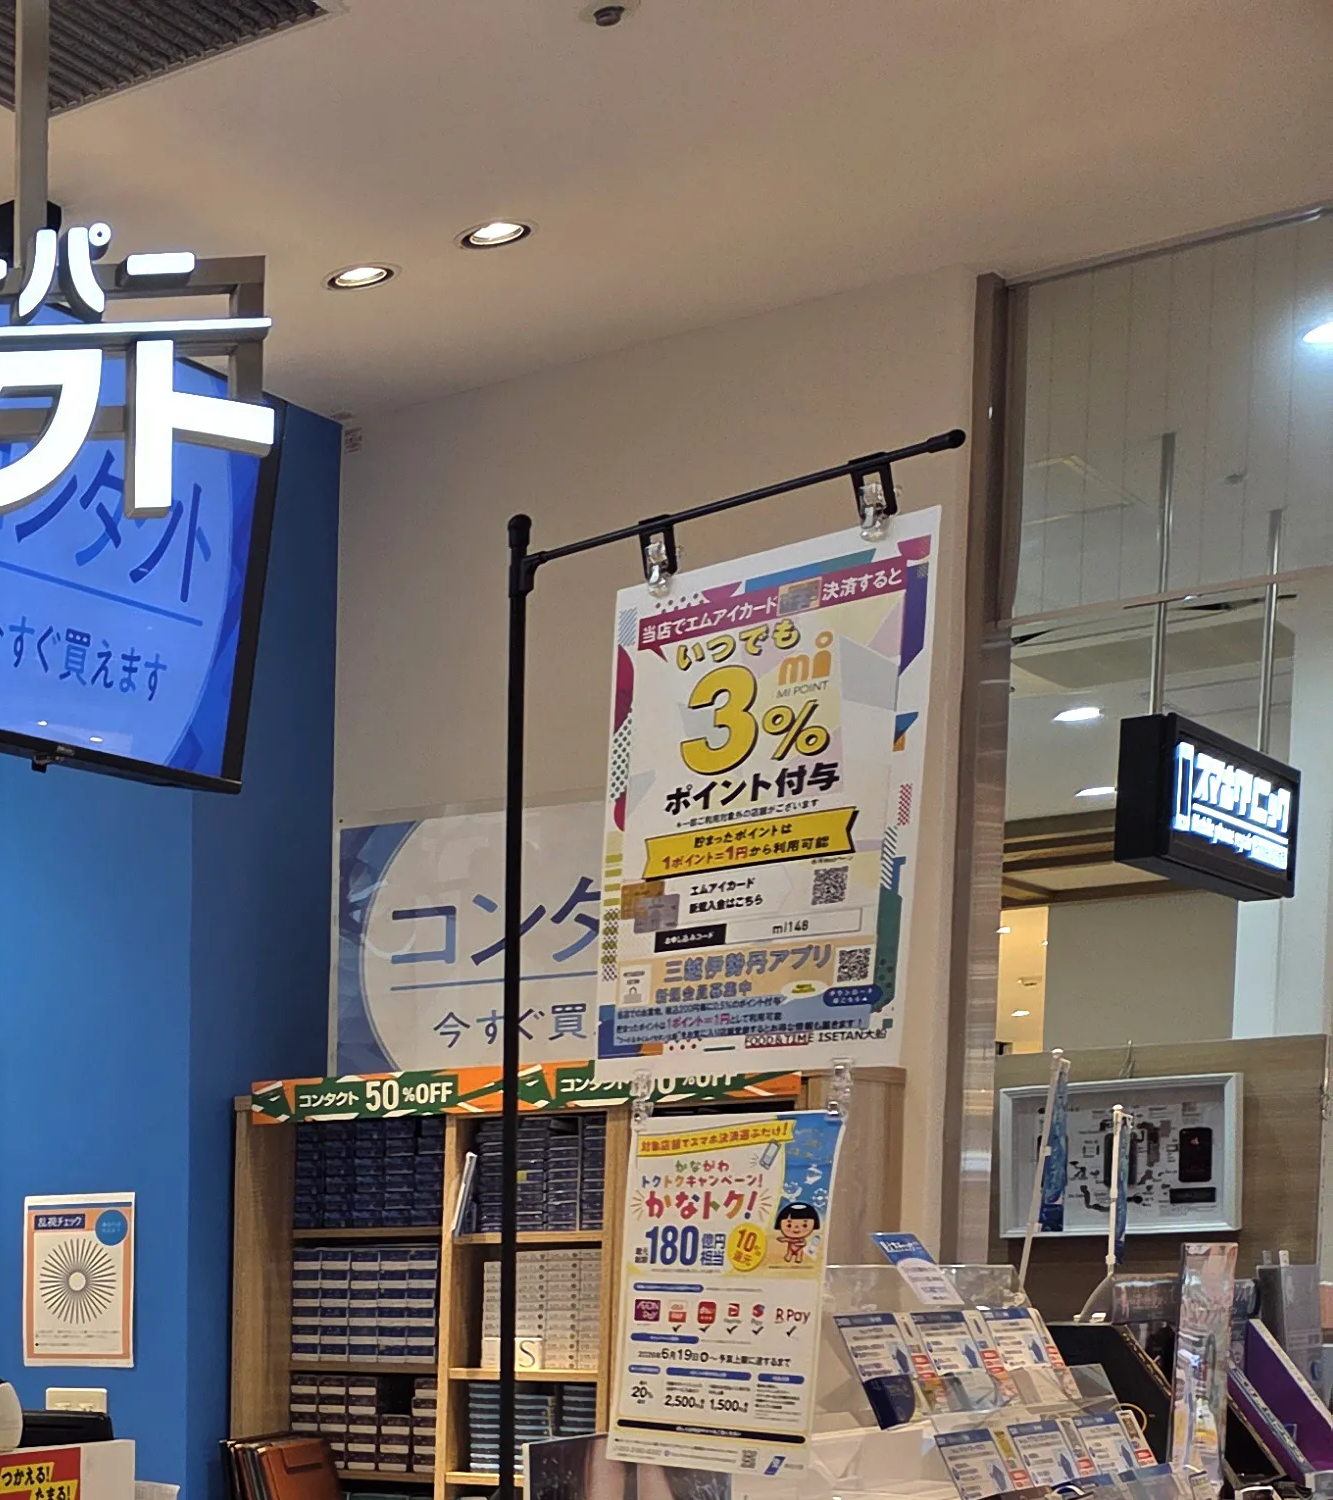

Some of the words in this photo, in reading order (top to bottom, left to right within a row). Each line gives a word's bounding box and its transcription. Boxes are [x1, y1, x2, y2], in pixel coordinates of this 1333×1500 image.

[642, 597, 777, 644] 当店でエムアイカード
[822, 568, 902, 601] 決済すると
[676, 619, 800, 671] いつでも
[793, 681, 830, 697] POINT
[680, 664, 830, 775] 3%
[665, 762, 841, 815] ポイント付与
[694, 824, 792, 848] 貯まったポイントは
[690, 877, 756, 896] エムアイカード
[689, 895, 763, 915] 新規入会はこちら
[664, 944, 832, 983] 三越伊勢丹アプリ
[298, 1089, 360, 1109] コンタクト
[364, 1079, 453, 1113] 50%OFF
[675, 1159, 729, 1172] かながわ
[641, 1174, 763, 1188] トクトクキャンペーン!
[645, 1190, 758, 1220] かなトク!
[645, 1225, 699, 1266] 180
[2, 1466, 50, 1486] つかえる!
